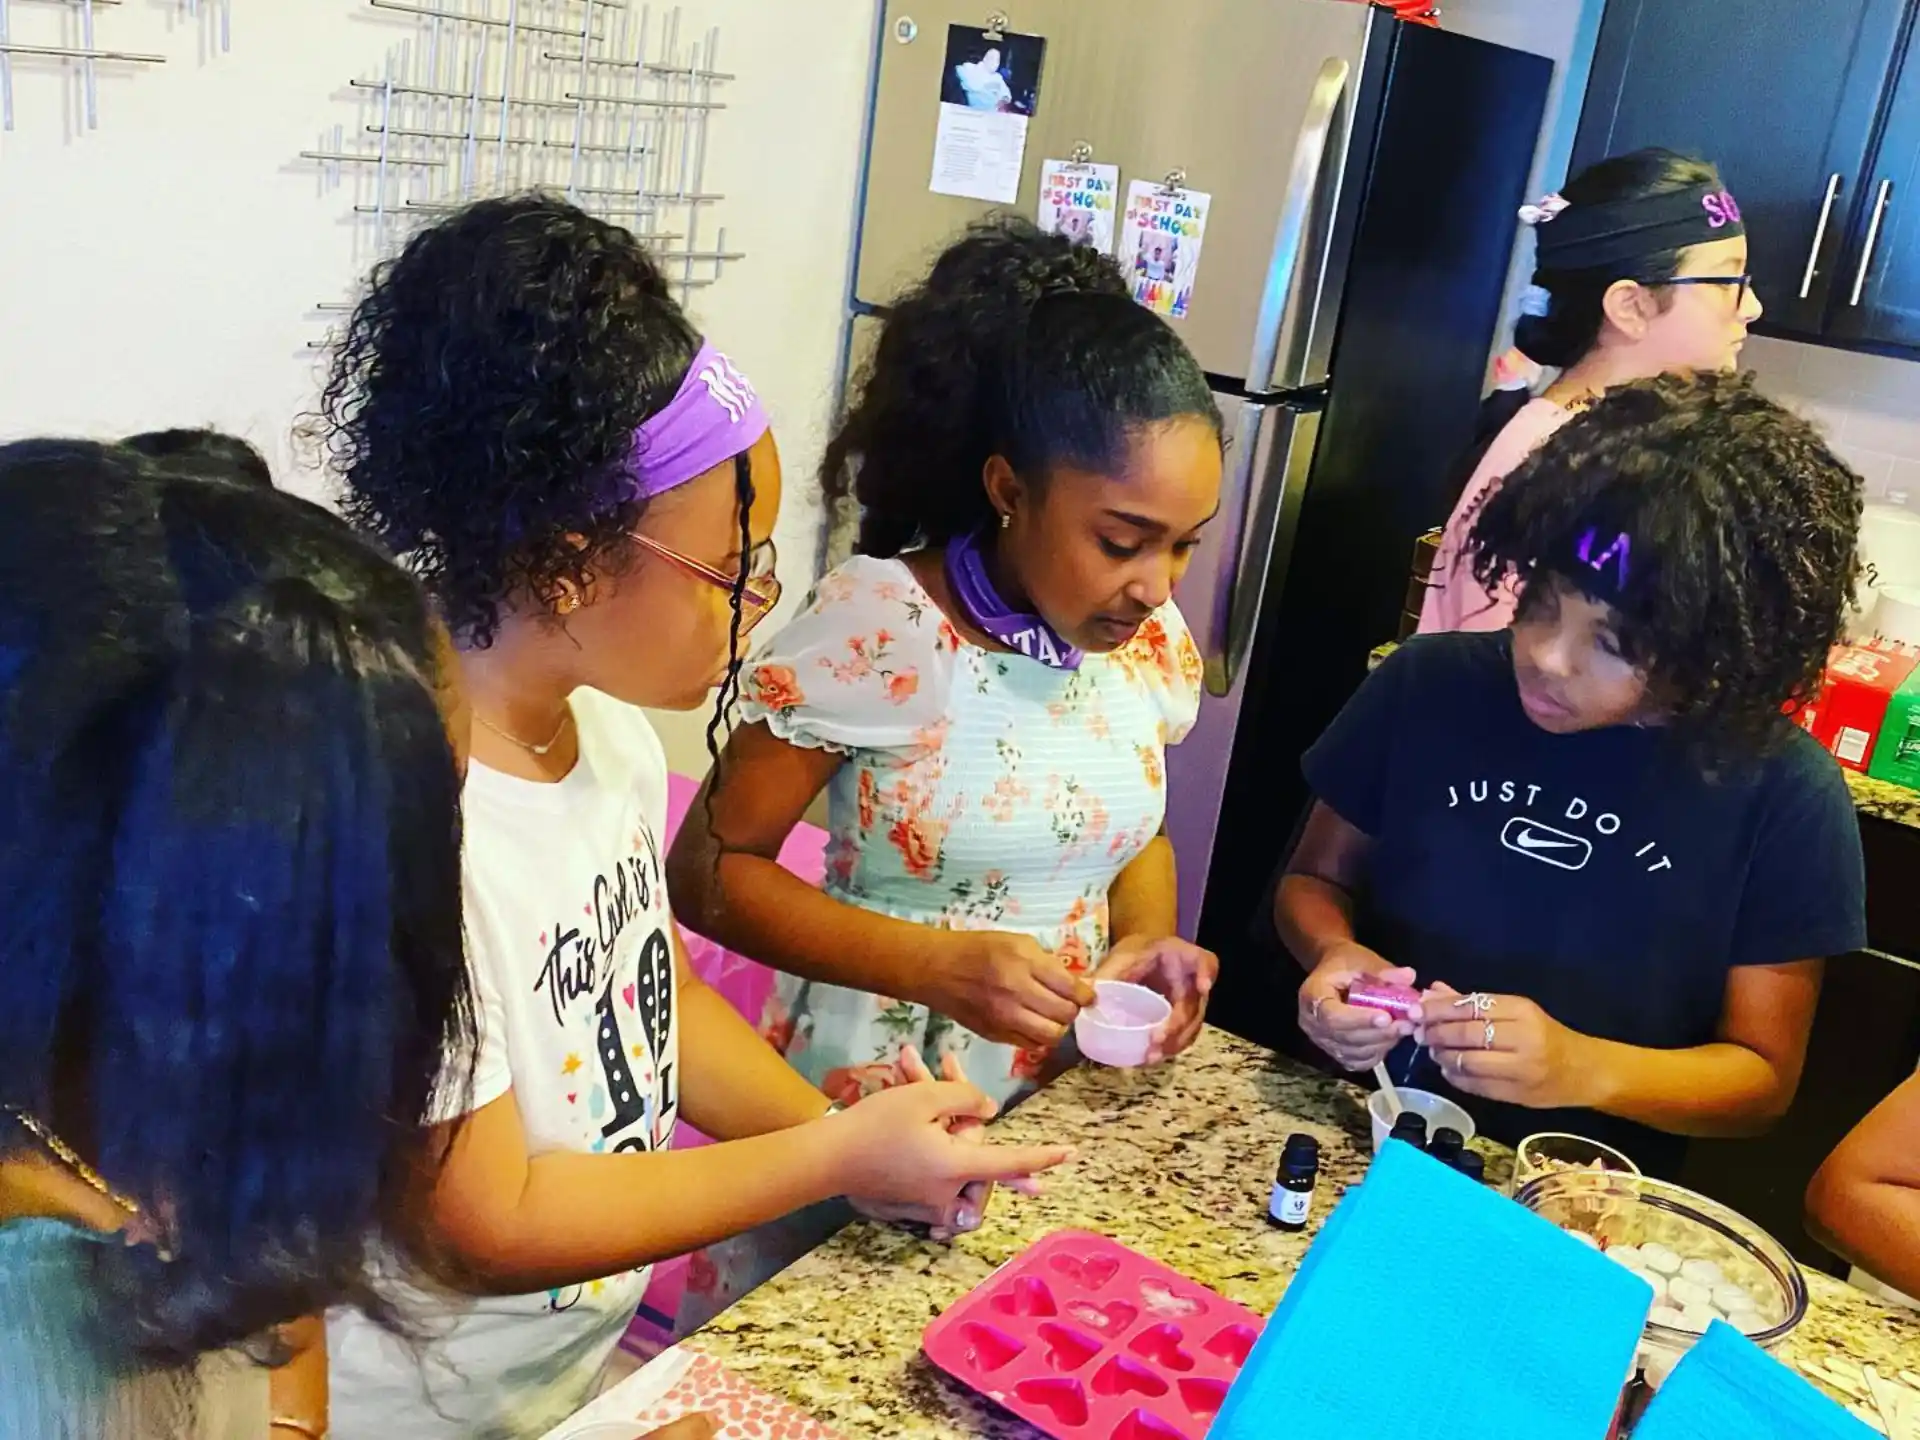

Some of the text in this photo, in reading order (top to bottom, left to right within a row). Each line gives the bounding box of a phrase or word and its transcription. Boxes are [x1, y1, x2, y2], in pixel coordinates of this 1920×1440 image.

[1048, 174, 1113, 192] FIRST DAY
[1052, 189, 1113, 211] SCHOOL
[1134, 195, 1201, 219] FIRST DAY
[1137, 212, 1201, 239] SCHOOL
[1448, 780, 1672, 872] JUST DO IT
[533, 922, 597, 1031] This
[593, 861, 634, 982] Girl
[627, 856, 651, 911] is
